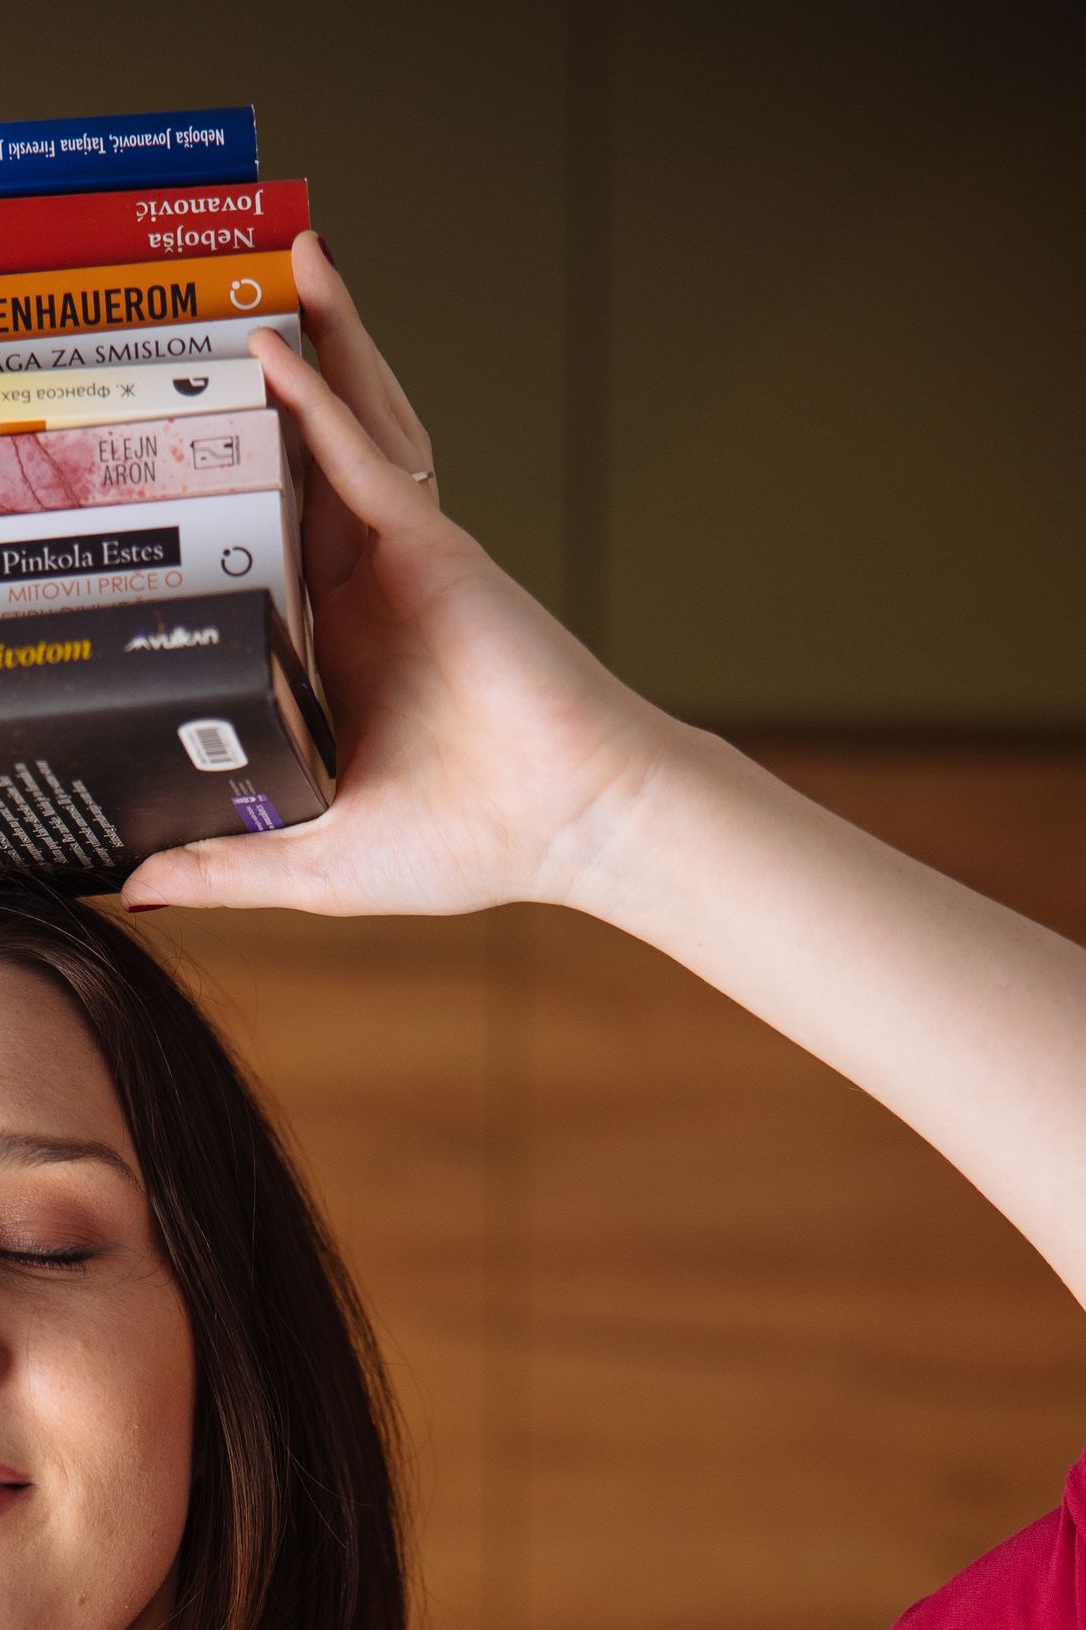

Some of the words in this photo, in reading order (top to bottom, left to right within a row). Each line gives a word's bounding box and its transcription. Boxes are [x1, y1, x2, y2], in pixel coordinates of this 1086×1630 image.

[60, 133, 106, 155] Tatjana
[109, 128, 171, 153] Jovanović,
[176, 126, 225, 148] Nebojša
[8, 140, 55, 161] Firevski
[136, 189, 264, 223] Jovanović
[148, 225, 255, 253] Nebojša
[51, 348, 85, 368] ZA
[96, 335, 213, 363] SMISLOM
[37, 382, 111, 399] Франсоа
[116, 383, 136, 398] Ж.
[98, 435, 158, 464] ELEJN
[102, 461, 157, 487] ARON
[3, 542, 94, 577] Pinkola
[102, 541, 165, 567] Estes
[8, 578, 83, 604] MITOVI
[86, 579, 93, 598] I
[97, 569, 160, 595] PRIČE
[165, 570, 183, 589] O
